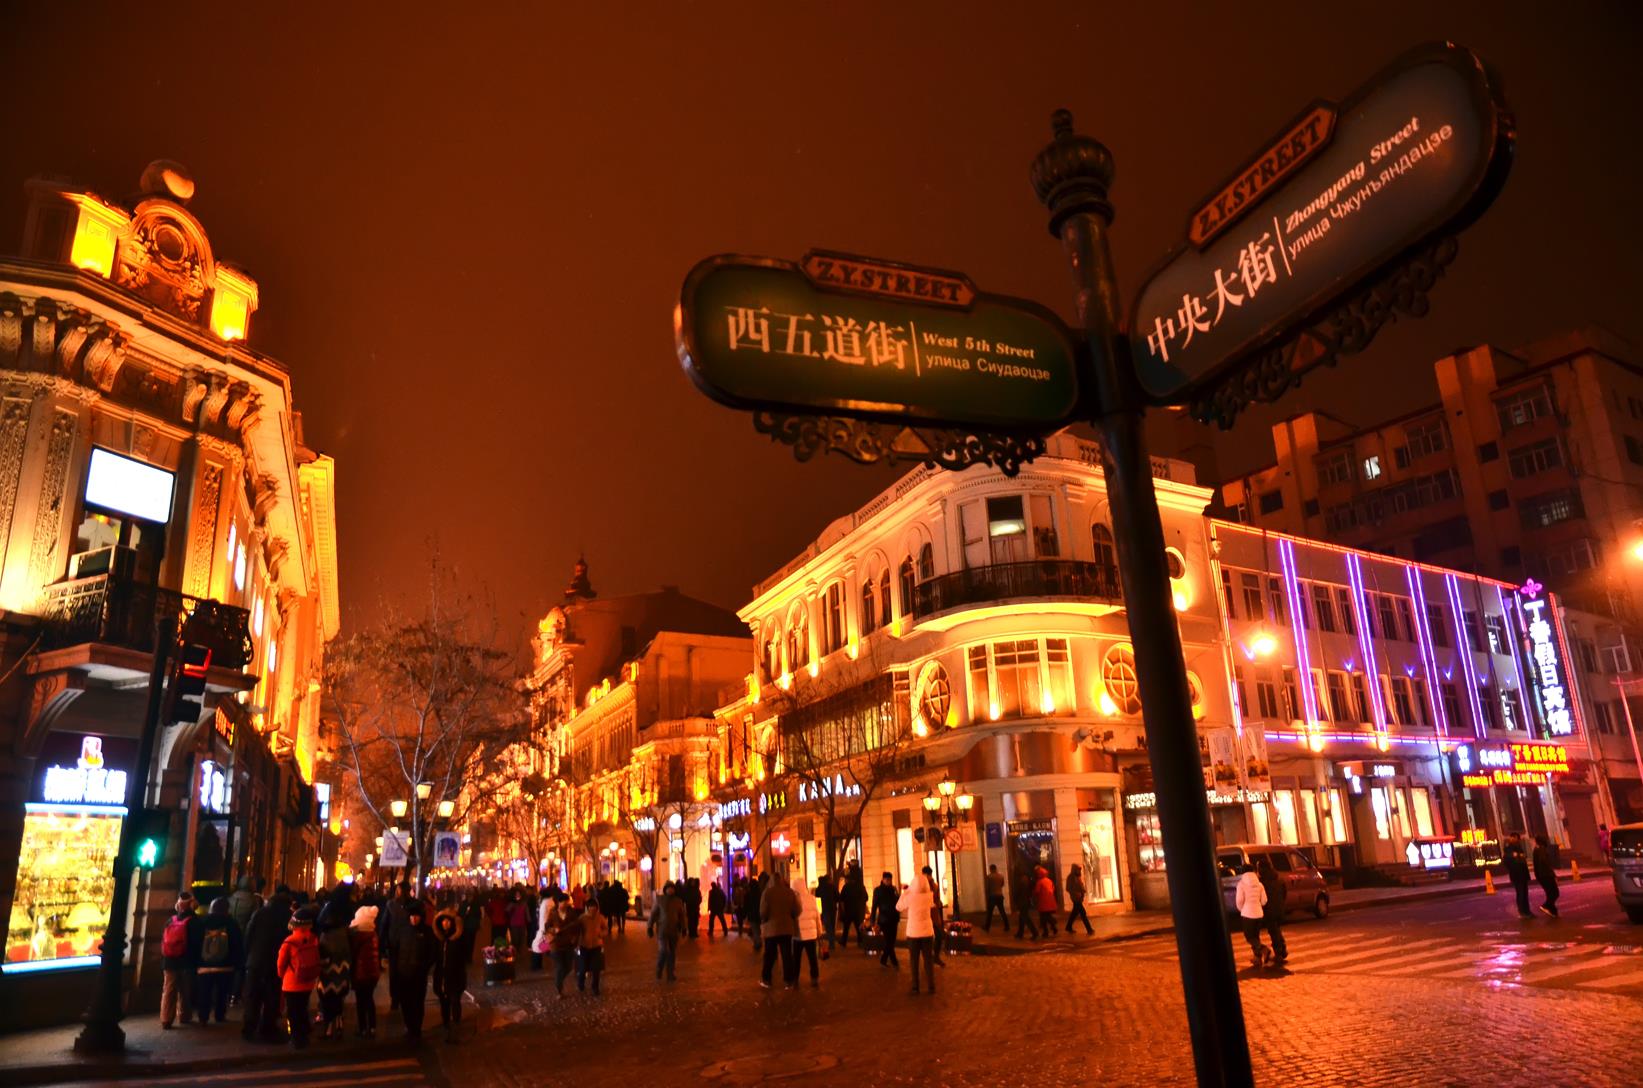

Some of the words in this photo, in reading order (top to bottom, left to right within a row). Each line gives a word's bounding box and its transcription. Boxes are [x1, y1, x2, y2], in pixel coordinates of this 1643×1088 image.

[1200, 116, 1322, 236] Z.Y.STREET
[1285, 162, 1366, 234] Zhongyang
[1370, 117, 1420, 163] Street
[1287, 219, 1330, 260] улица
[1330, 124, 1453, 220] Чжунъяндацзе
[816, 260, 964, 302] Z.Y.STREET
[1146, 232, 1279, 363] 中央大街
[724, 305, 908, 370] 西五道街
[922, 332, 957, 349] West
[965, 336, 990, 353] 5th
[996, 341, 1036, 359] Street
[926, 353, 970, 372] улица
[977, 358, 1051, 382] Сиудаоцзе
